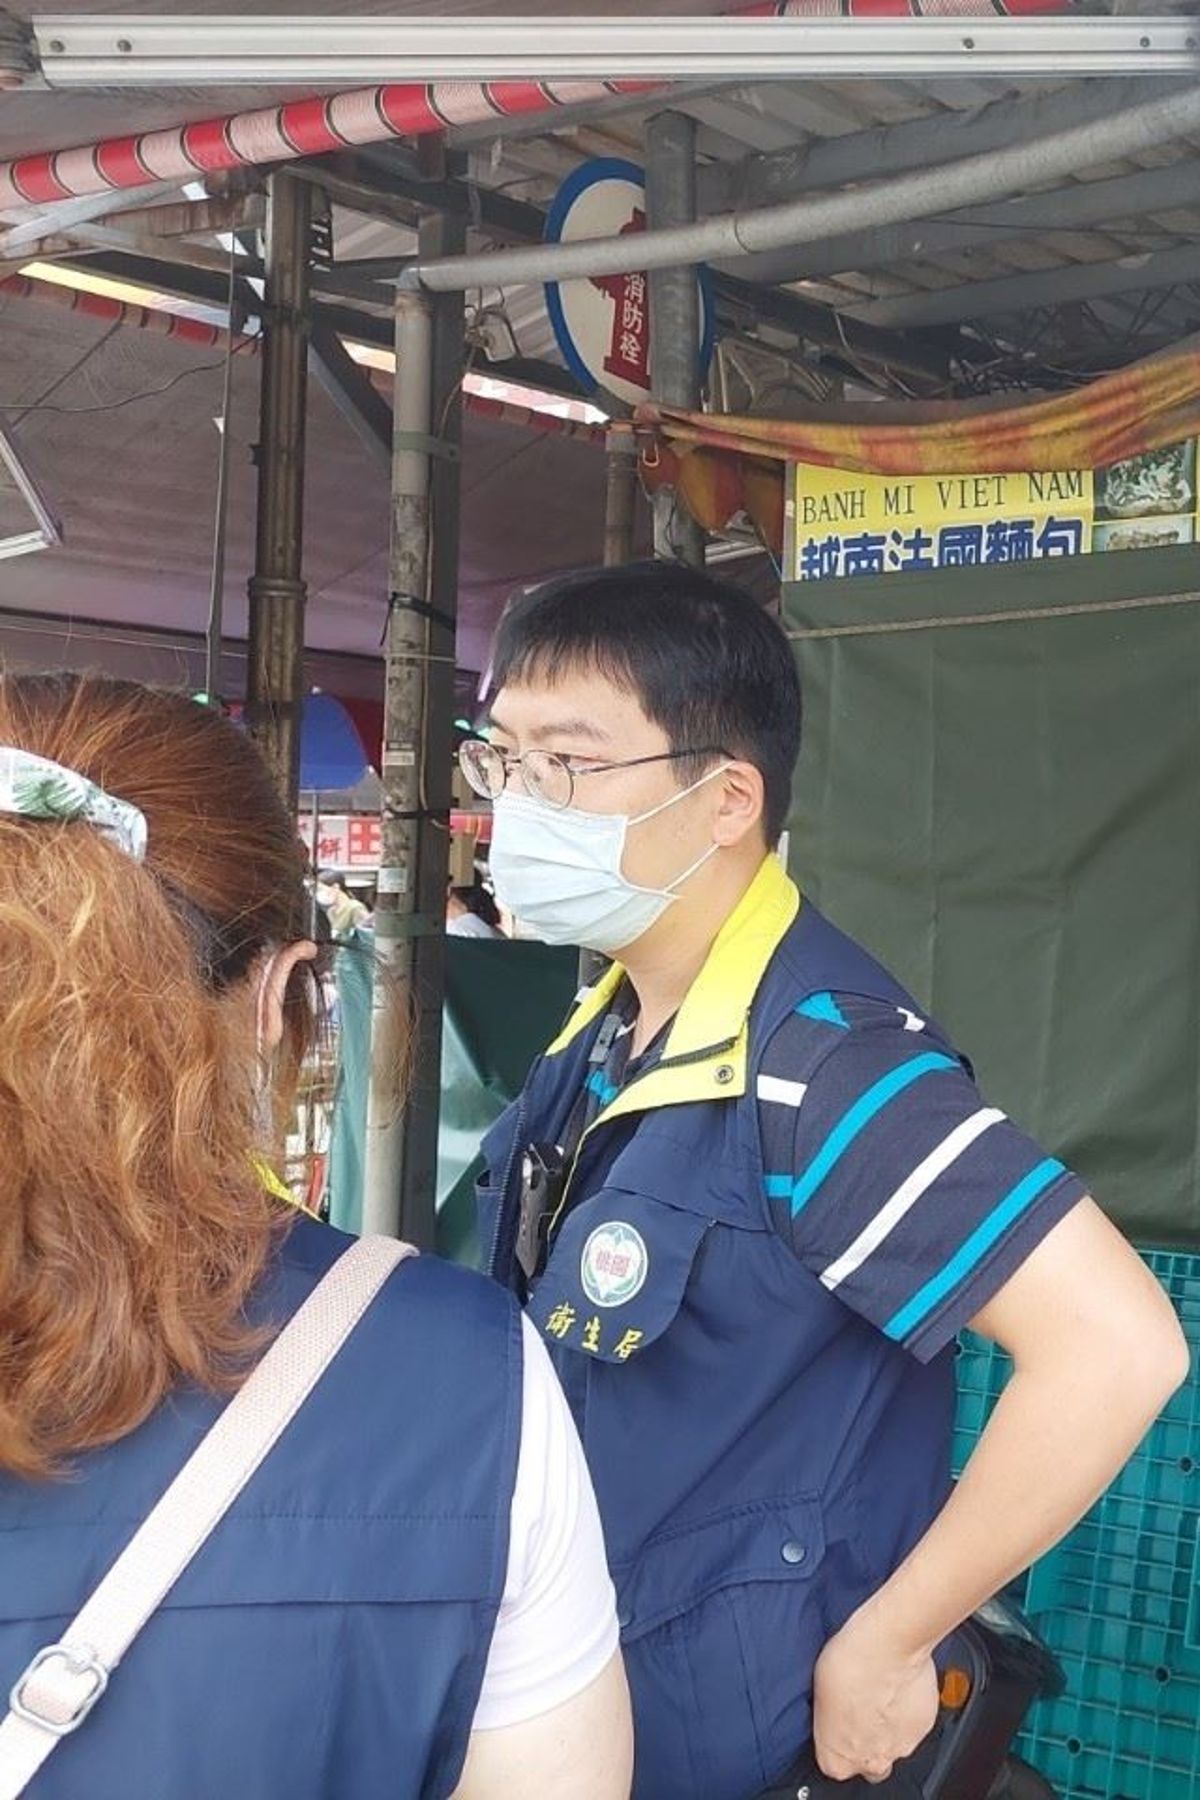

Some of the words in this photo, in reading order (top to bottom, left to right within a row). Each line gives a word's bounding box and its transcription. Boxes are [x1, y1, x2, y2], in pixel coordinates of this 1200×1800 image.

[803, 489, 866, 524] BANH
[883, 484, 915, 516] MI
[936, 475, 1008, 510] VIET
[1026, 469, 1083, 503] NAM
